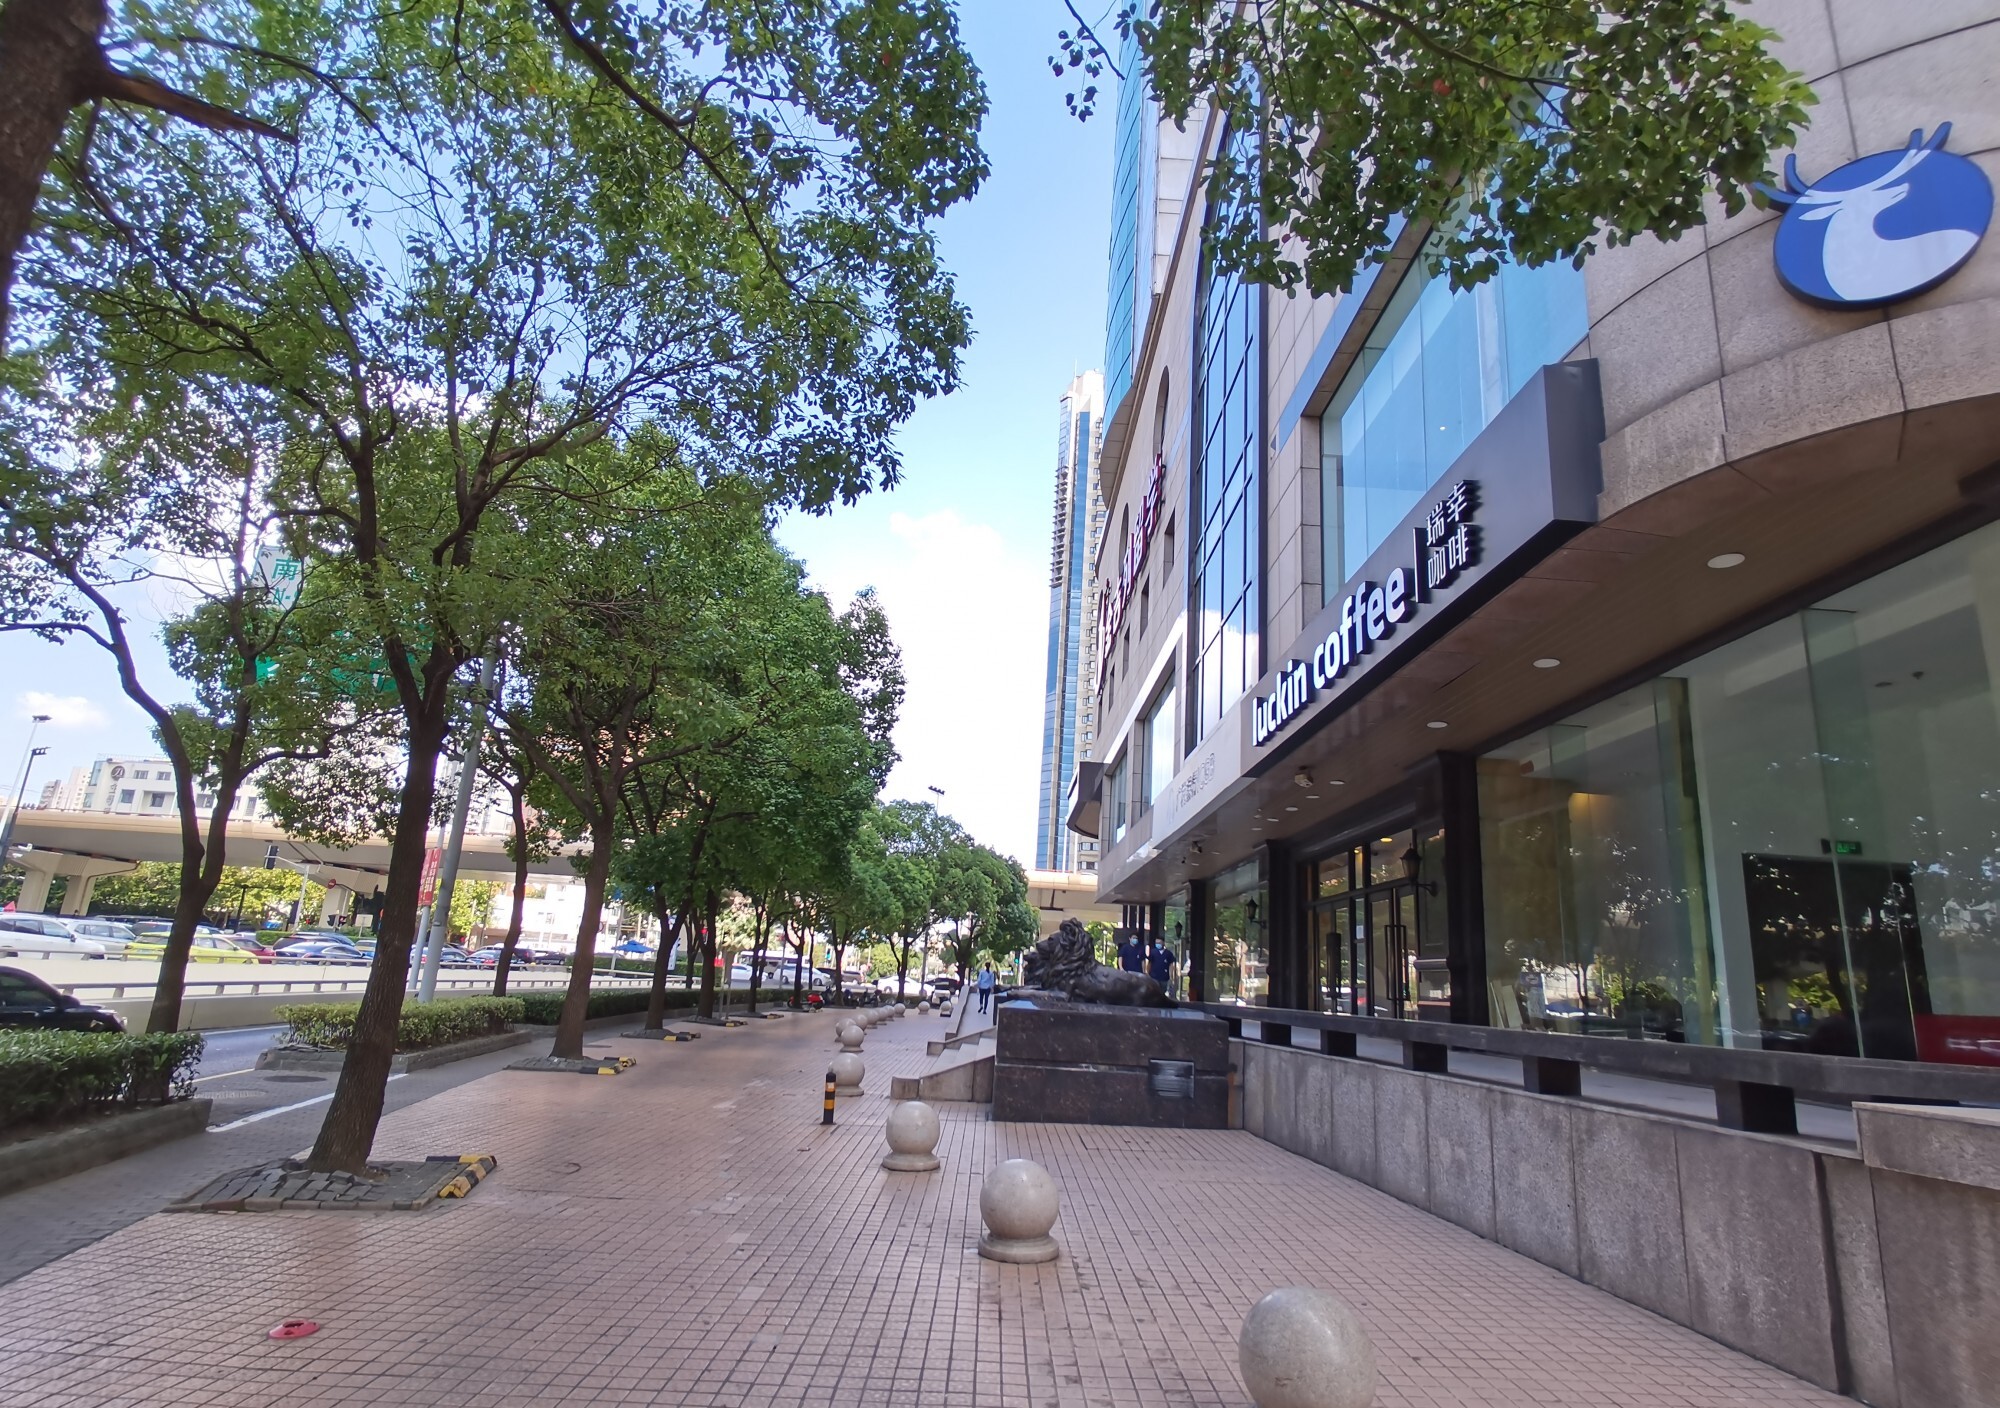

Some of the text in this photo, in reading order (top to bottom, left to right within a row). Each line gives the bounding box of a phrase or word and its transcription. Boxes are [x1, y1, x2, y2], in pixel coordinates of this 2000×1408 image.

[1426, 480, 1467, 546] 瑞幸
[272, 556, 302, 581] 南
[1428, 525, 1469, 589] 咖啡
[1252, 567, 1405, 747] luckin coffee
